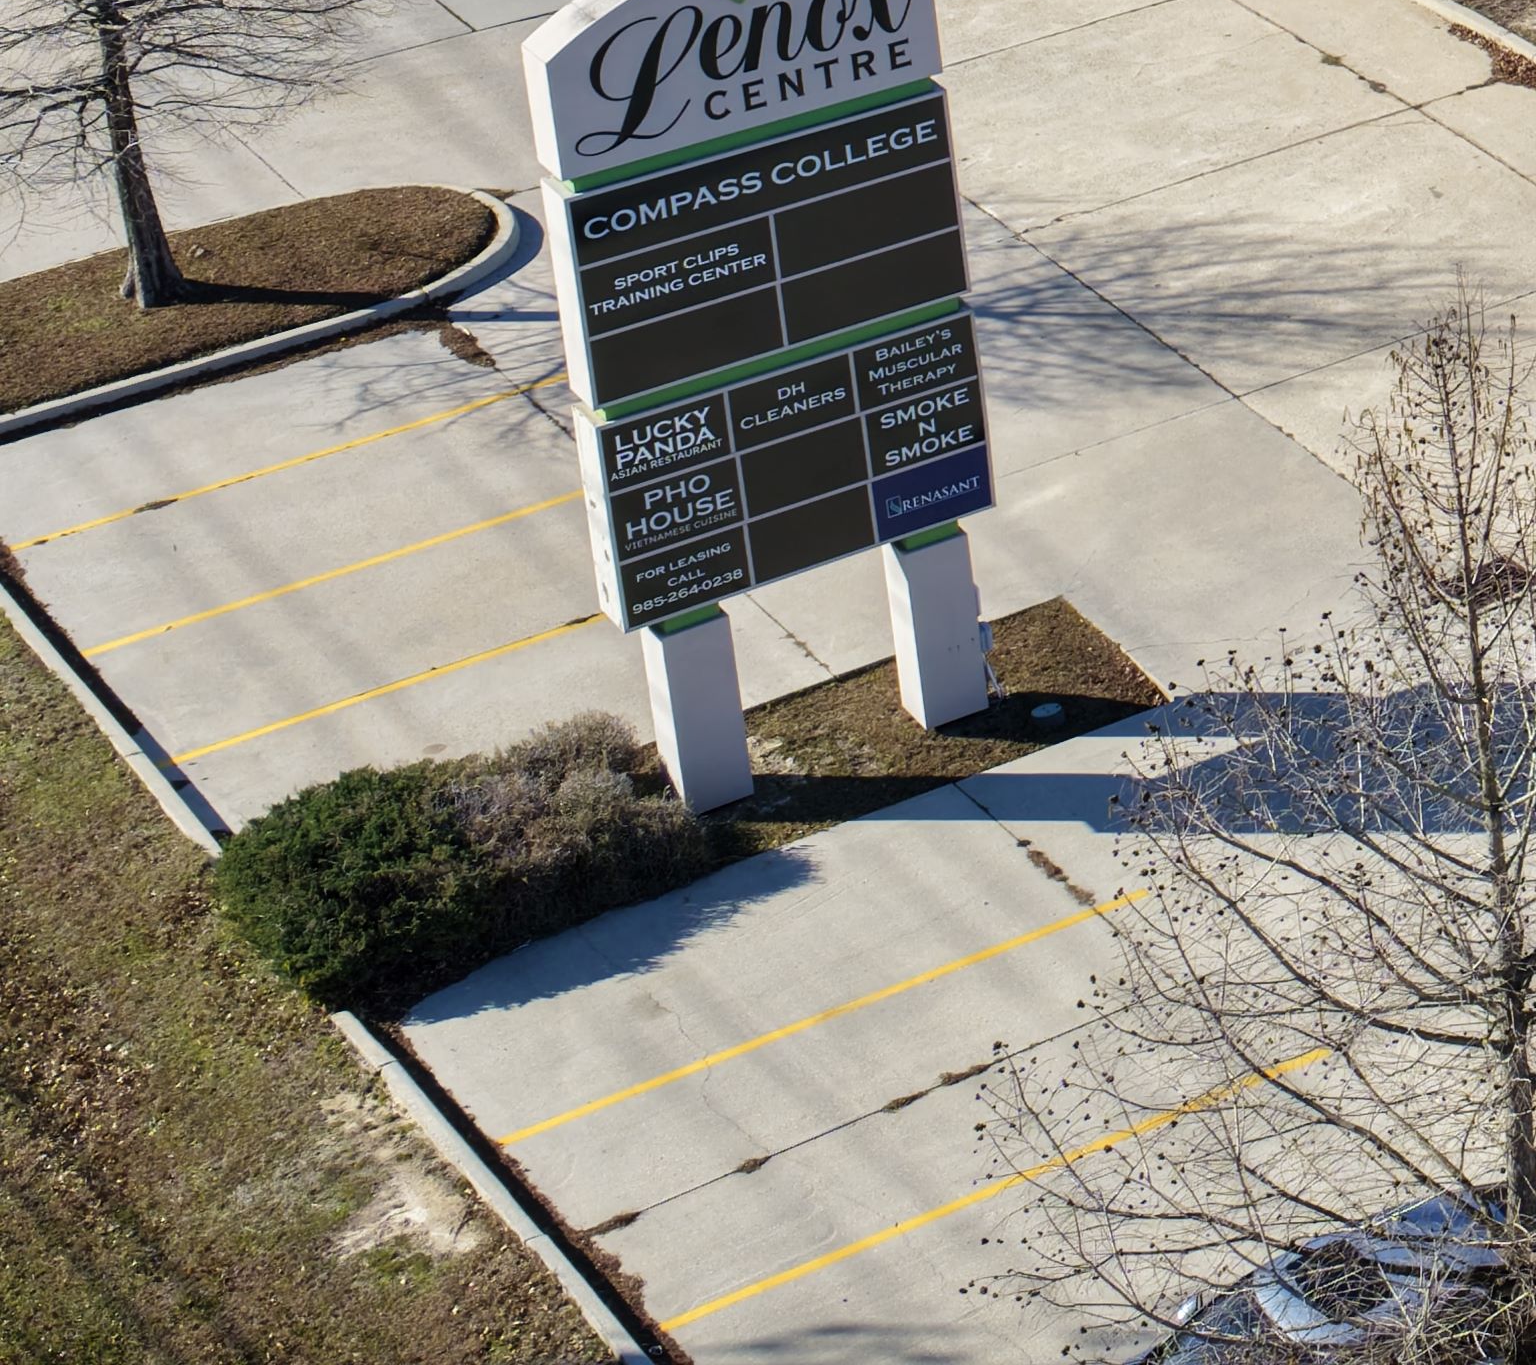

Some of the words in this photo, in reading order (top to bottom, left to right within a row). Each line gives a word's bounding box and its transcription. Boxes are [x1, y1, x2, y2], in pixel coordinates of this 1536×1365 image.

[703, 38, 913, 121] CENTRE
[583, 172, 763, 240] COMPASS
[770, 119, 938, 186] COLLEGE
[589, 278, 685, 316] TRAINING
[688, 253, 768, 287] CENTER
[614, 260, 680, 290] SPORT
[682, 243, 740, 270] CLIPS
[868, 343, 963, 382] MUSCULAR
[875, 328, 952, 362] BAILEY'S
[777, 381, 806, 401] DH
[877, 363, 958, 396] THERAPY
[615, 406, 711, 451] LUCKY
[740, 387, 847, 430] CLEANERS
[880, 387, 971, 429] SMOKE
[918, 418, 937, 437] N
[610, 462, 648, 482] ASIAN
[650, 438, 723, 470] RESTAURANT
[616, 426, 716, 469] PANDA
[885, 424, 975, 467] SMOKE
[643, 474, 711, 510] PHO
[902, 475, 981, 512] RENASANT
[624, 524, 692, 552] VIETNAMESE
[693, 508, 738, 530] CUISINE
[625, 488, 736, 541] HOUSE
[635, 565, 666, 584] FOR
[669, 542, 732, 572] LEASING
[667, 569, 706, 587] CALL
[632, 568, 744, 615] 985-264-0238
